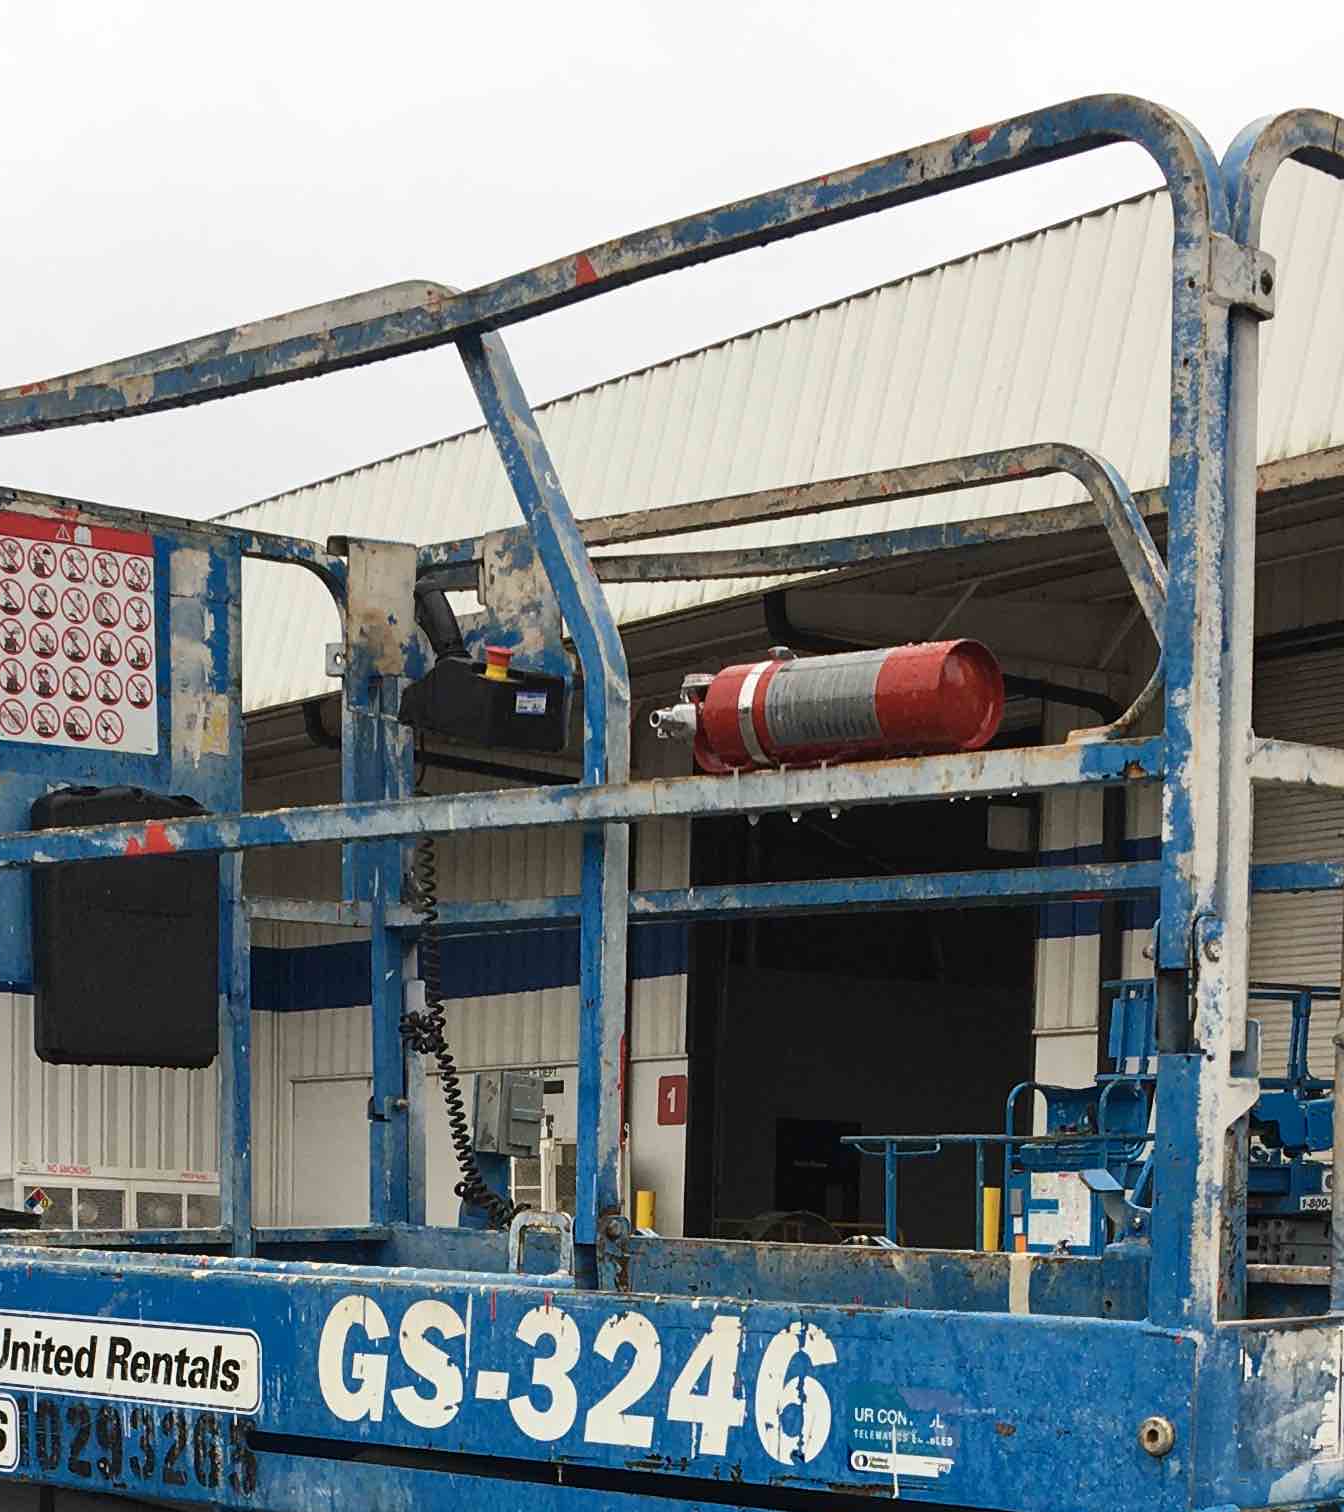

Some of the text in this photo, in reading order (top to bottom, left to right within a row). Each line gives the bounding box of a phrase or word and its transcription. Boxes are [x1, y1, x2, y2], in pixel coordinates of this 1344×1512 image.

[666, 1087, 677, 1113] 1
[106, 1336, 242, 1393] Rentals
[317, 1294, 839, 1466] GS-3246
[854, 1407, 875, 1423] UR
